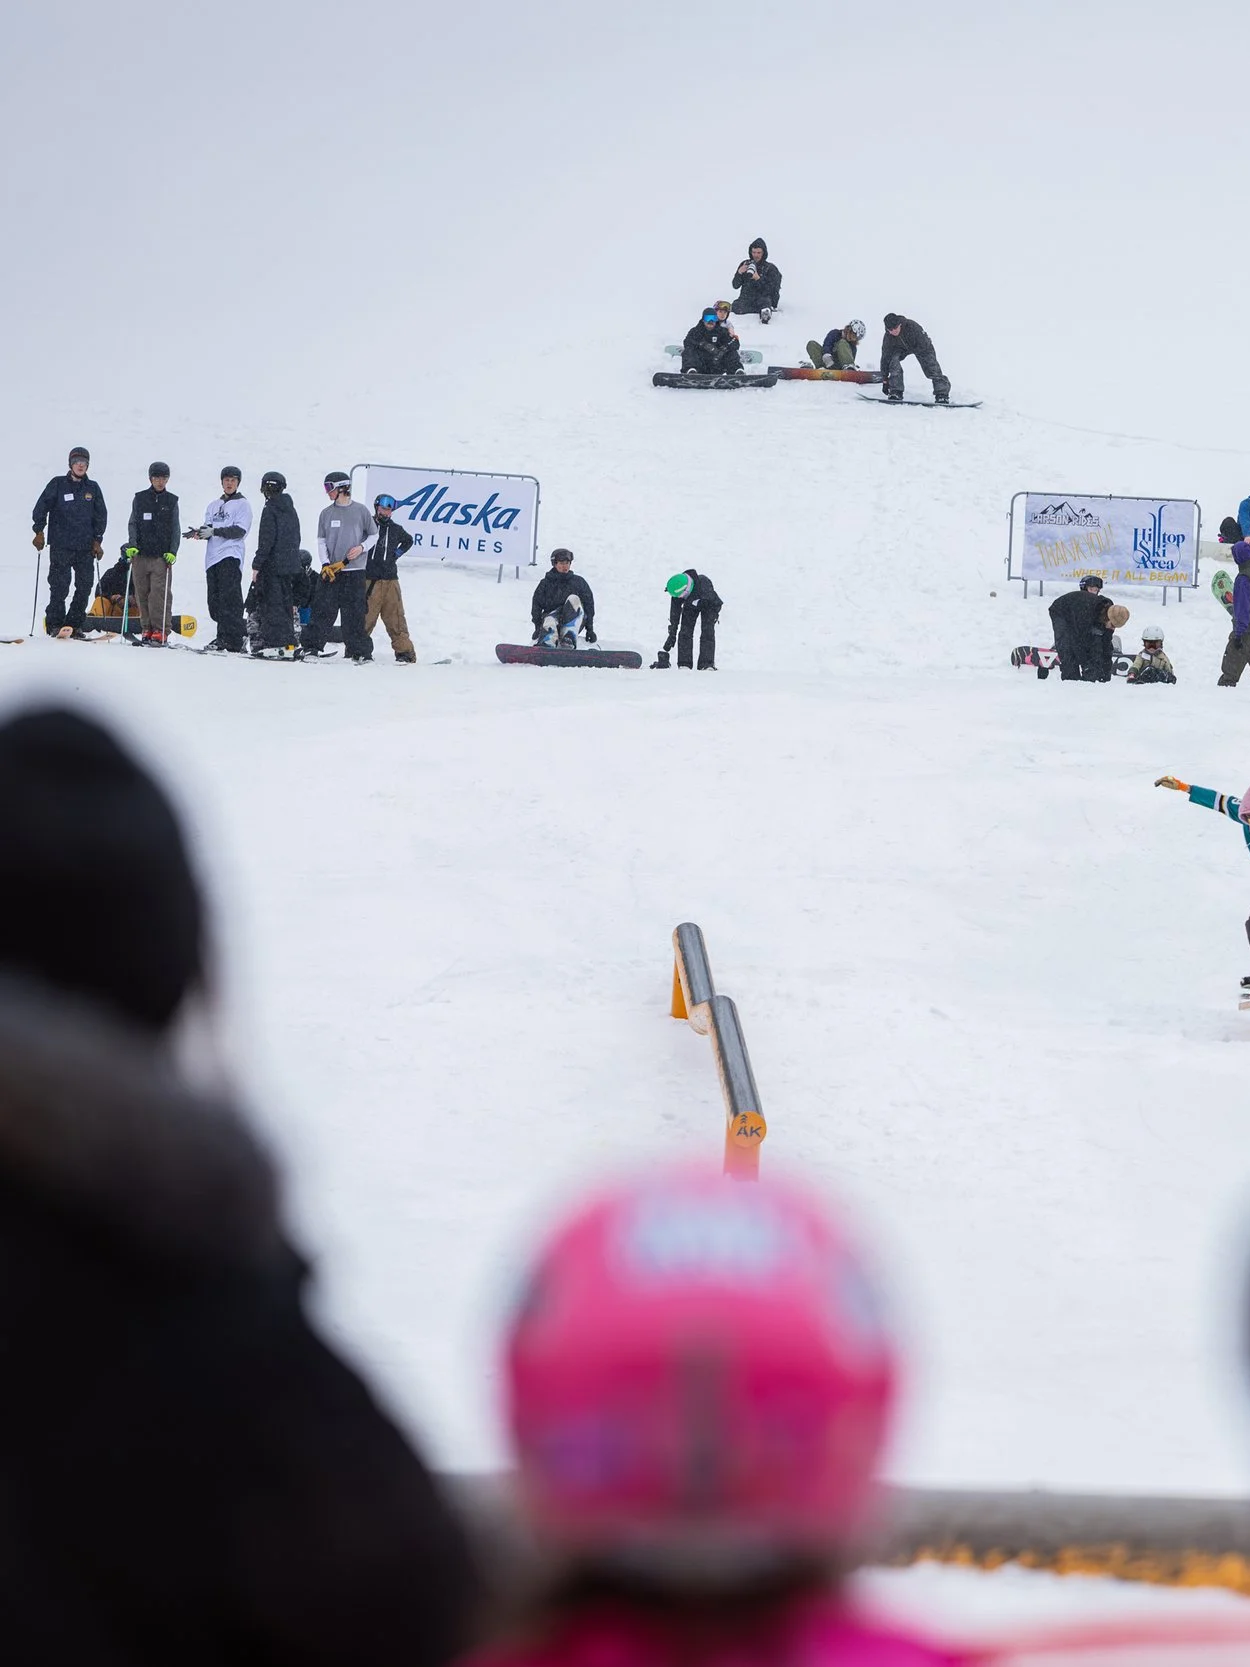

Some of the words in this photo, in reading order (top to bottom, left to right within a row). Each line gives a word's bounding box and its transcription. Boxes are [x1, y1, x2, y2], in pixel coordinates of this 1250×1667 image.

[395, 483, 521, 534] Alaska
[1031, 513, 1070, 526] LARSON
[1071, 515, 1100, 528] RIDES
[1133, 504, 1186, 551] Hilltop
[413, 533, 503, 554] RLINES
[1035, 533, 1088, 569] THANK
[1138, 540, 1166, 561] Ski
[1136, 555, 1175, 570] Area
[1112, 569, 1121, 581] IT
[1124, 570, 1146, 581] ALL
[1149, 572, 1188, 582] BEGAN
[736, 1126, 761, 1137] AK
